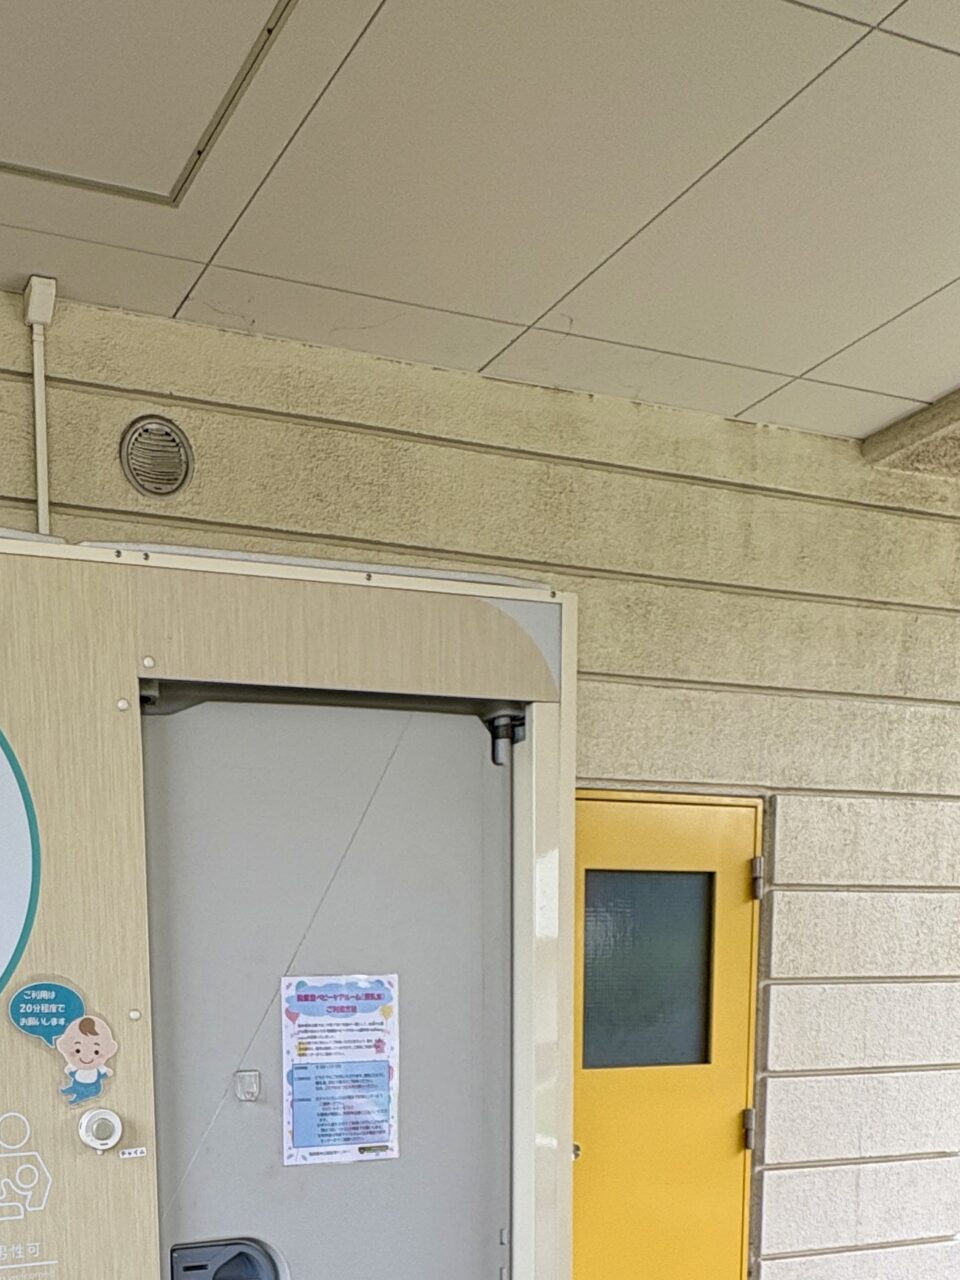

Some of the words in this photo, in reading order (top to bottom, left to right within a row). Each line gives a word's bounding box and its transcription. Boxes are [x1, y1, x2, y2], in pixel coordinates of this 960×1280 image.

[23, 989, 56, 1001] ご利用は
[19, 1003, 66, 1014] 20分程度で
